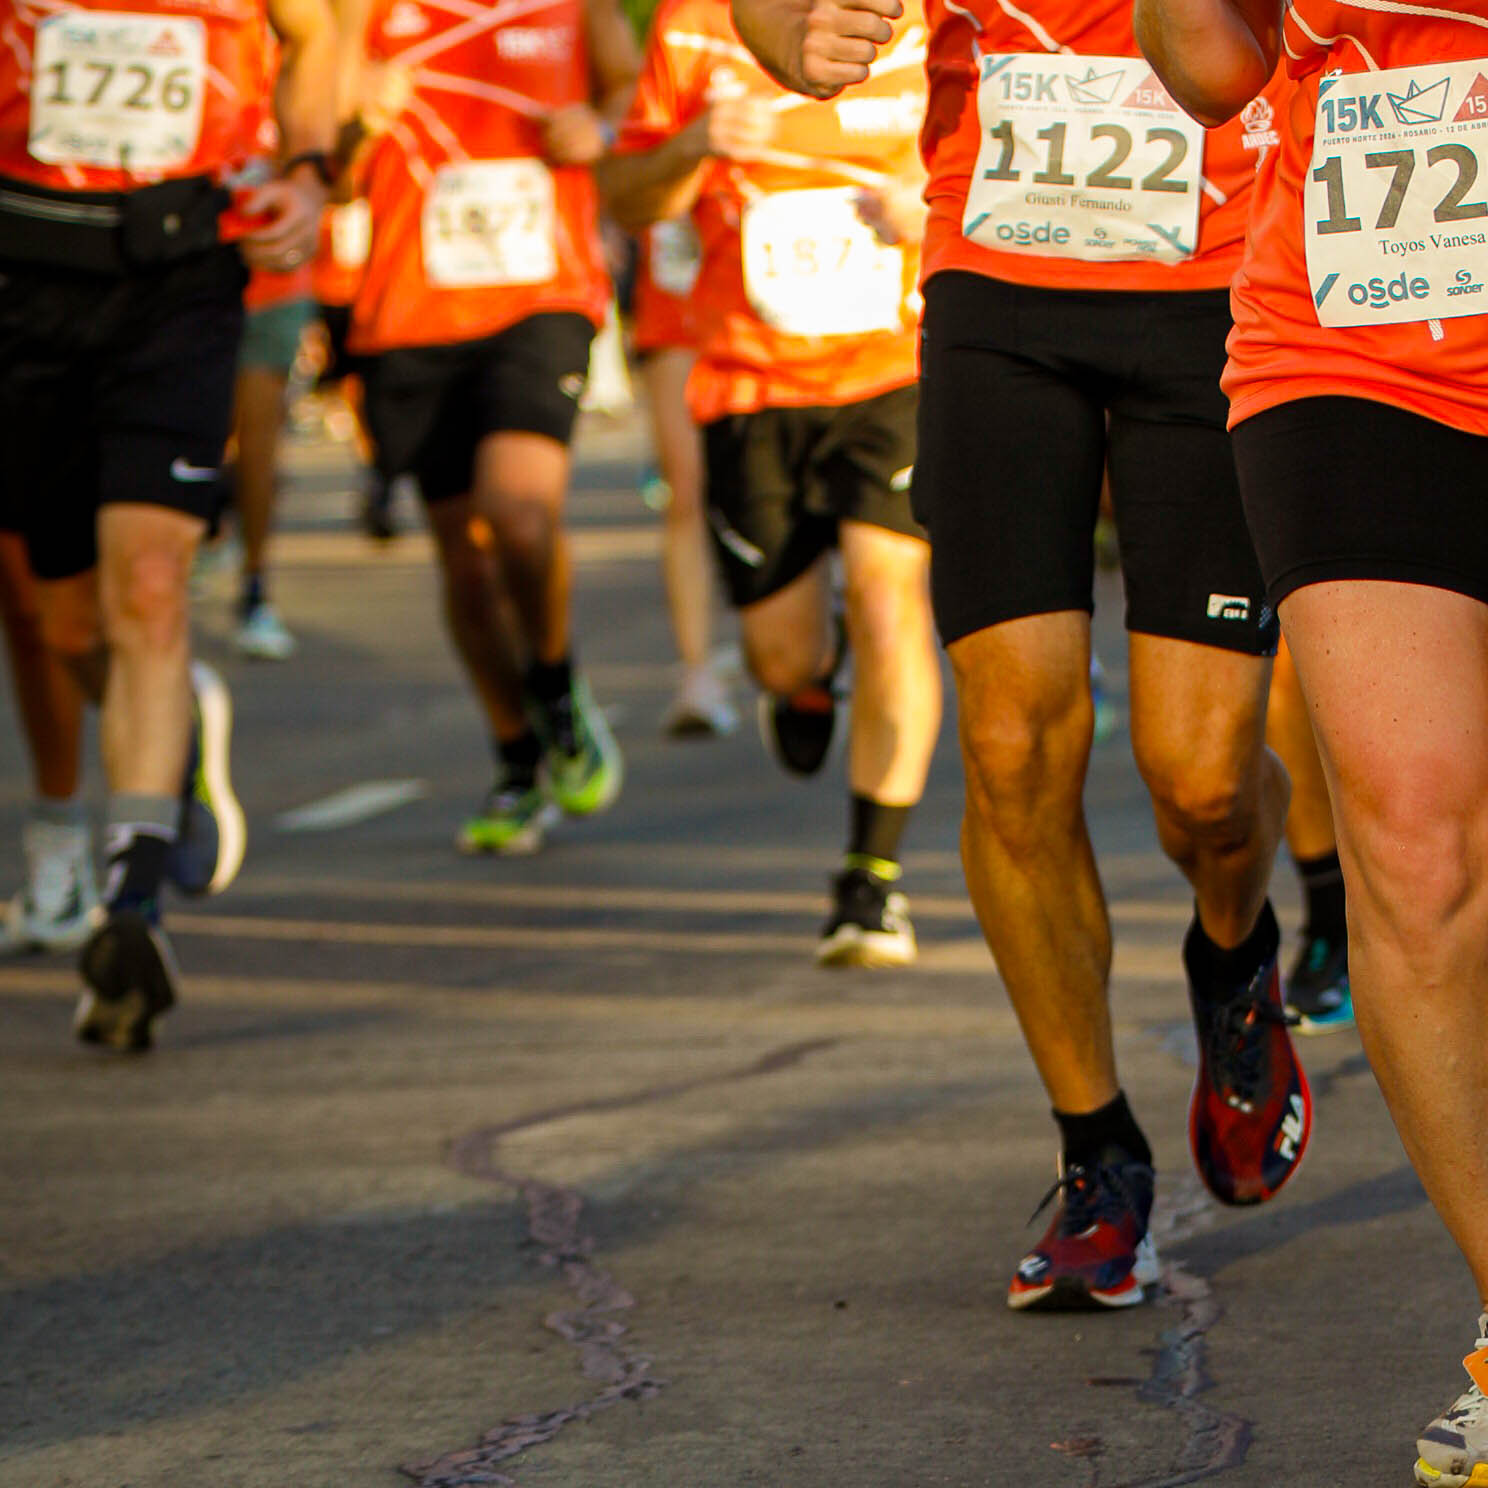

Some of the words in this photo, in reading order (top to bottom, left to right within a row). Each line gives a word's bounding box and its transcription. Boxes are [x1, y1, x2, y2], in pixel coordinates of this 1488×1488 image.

[45, 60, 192, 114] 1726
[1000, 71, 1058, 101] 15K
[1134, 89, 1166, 106] 15K
[1321, 93, 1385, 134] 15K
[1403, 127, 1437, 138] ROSARIO
[983, 119, 1189, 194] 1122
[996, 220, 1071, 245] osde
[1379, 239, 1426, 257] Toyos
[1429, 232, 1487, 250] Vanesa
[1347, 271, 1431, 308] osde
